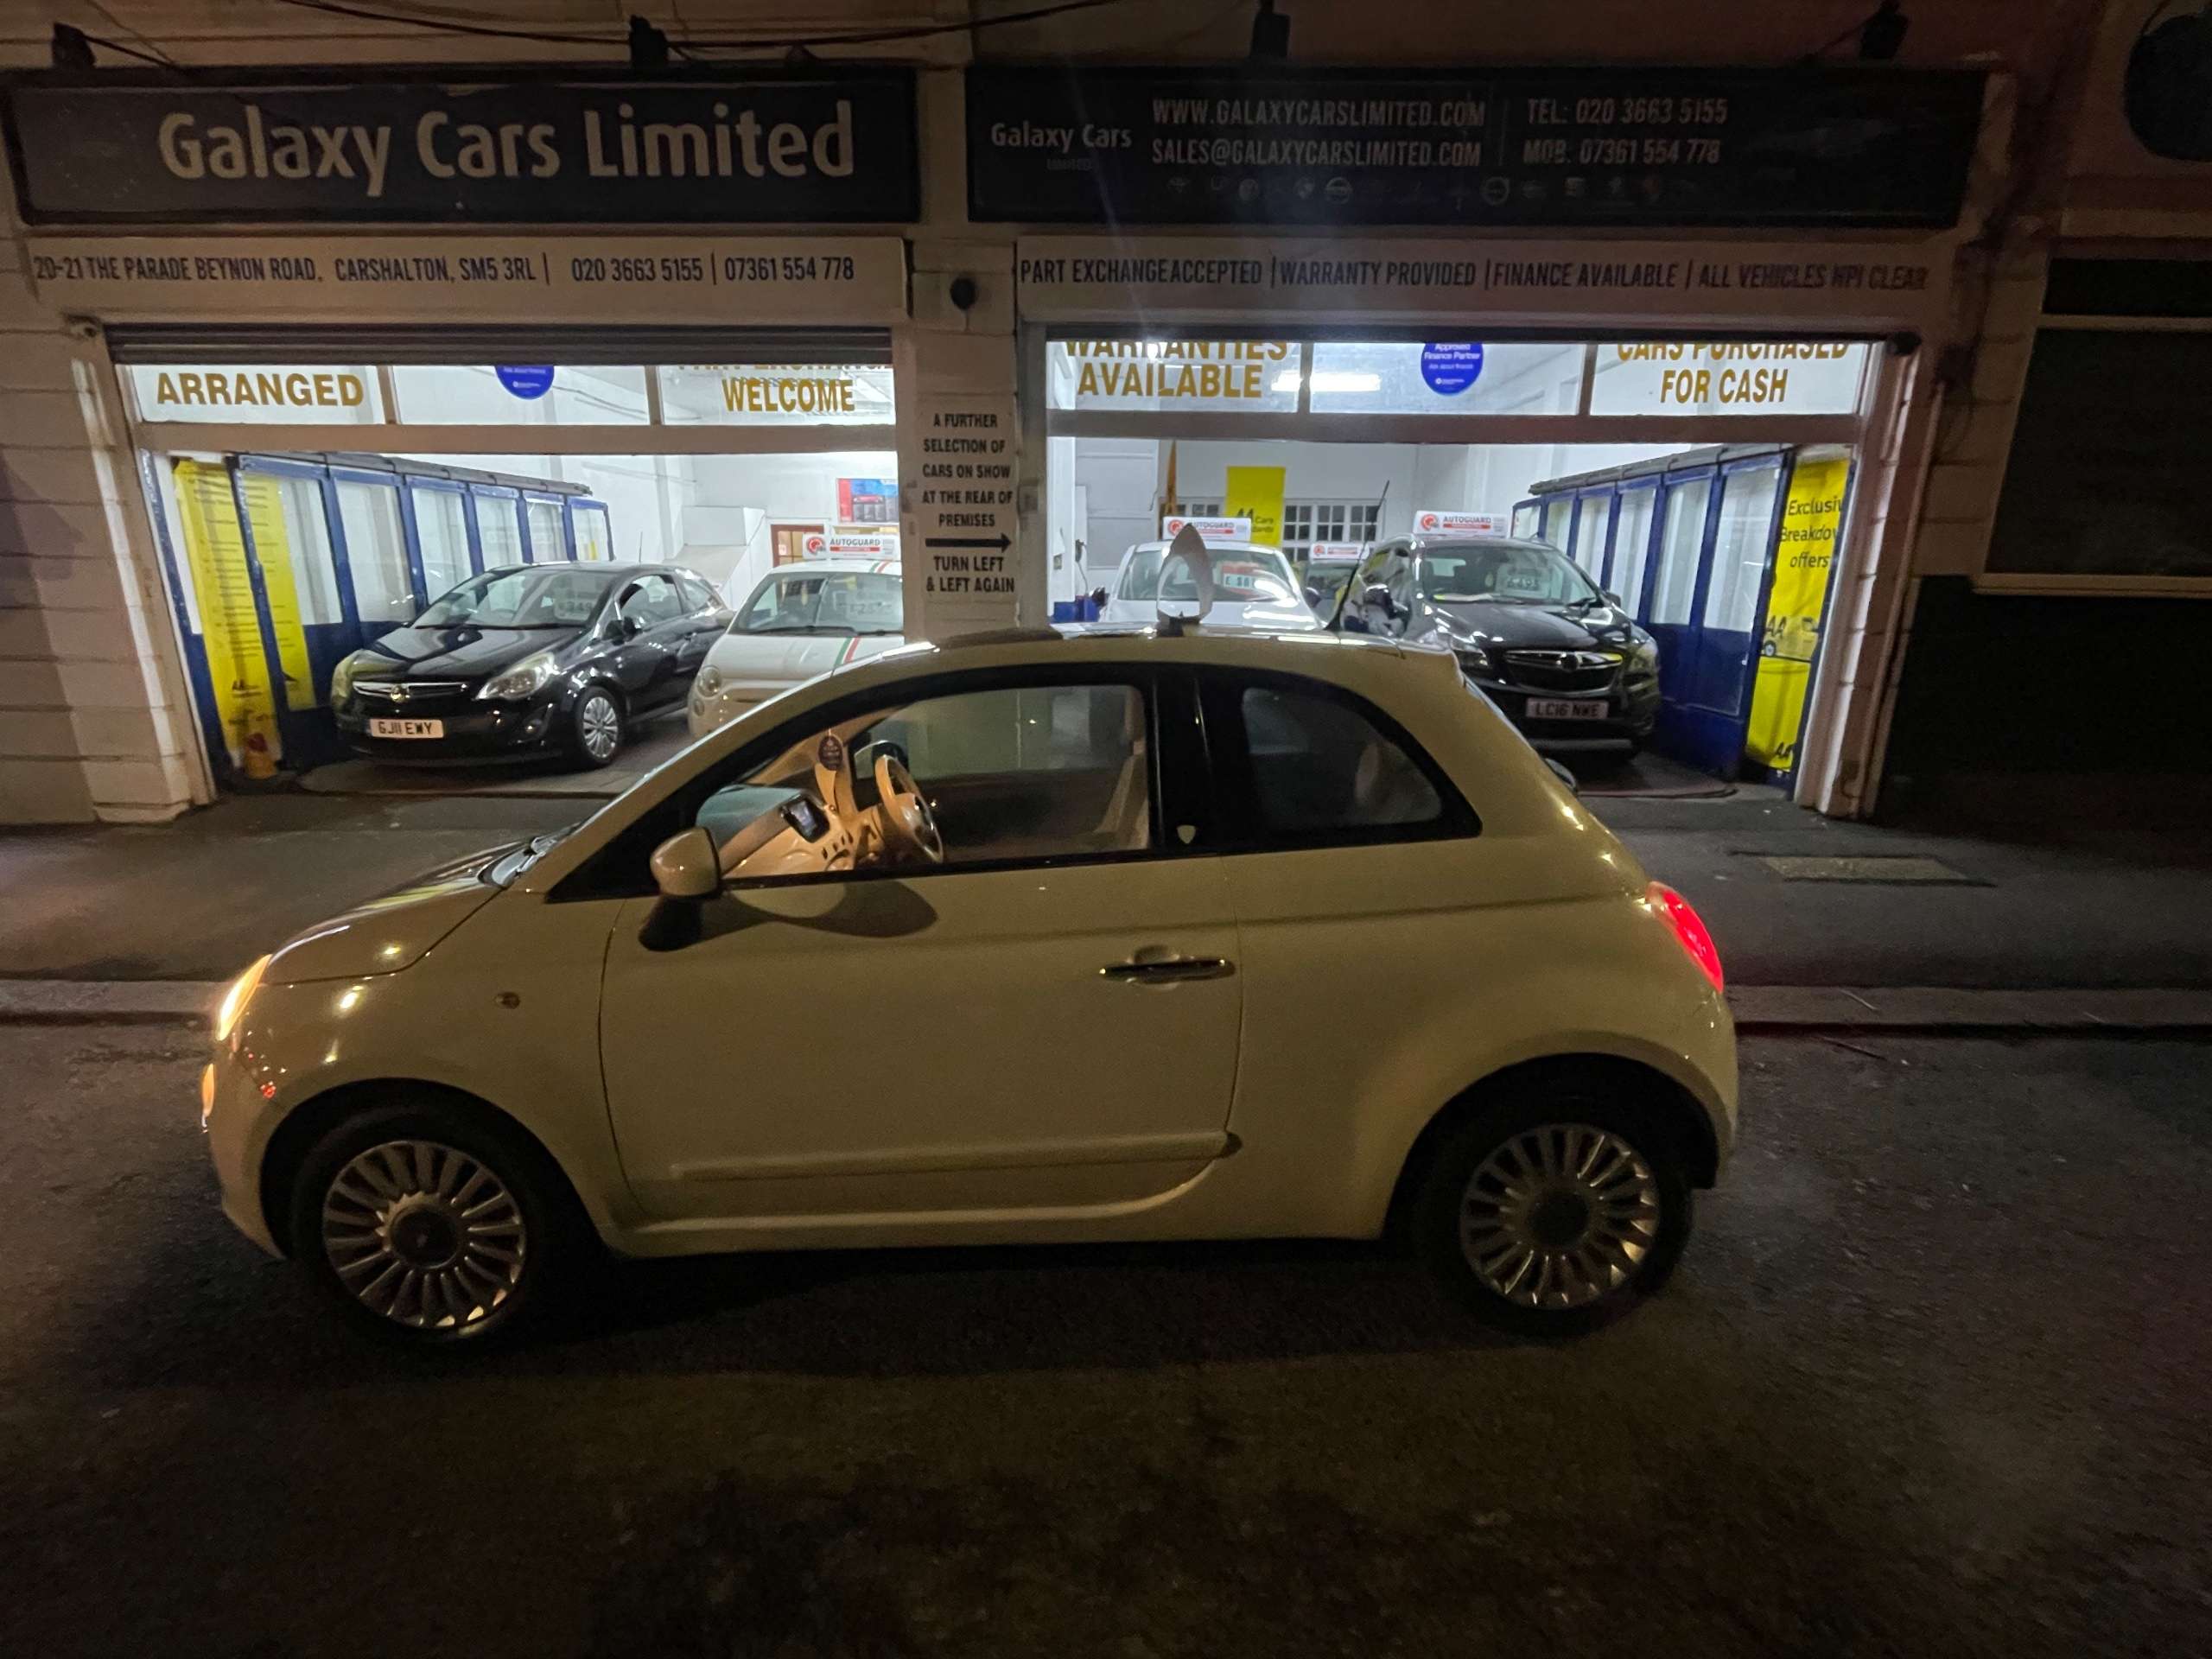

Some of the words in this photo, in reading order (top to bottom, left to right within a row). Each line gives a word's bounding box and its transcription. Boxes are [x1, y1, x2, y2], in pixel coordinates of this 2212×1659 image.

[1152, 98, 1485, 127] WWW.GALAXYCARSLIMITED.COM
[1527, 96, 1568, 124] TEL:
[1575, 97, 1616, 124] 020
[1619, 97, 1674, 124] 3663
[1678, 97, 1728, 124] 5155
[158, 105, 391, 197] Galaxy
[416, 111, 561, 179] Cars
[583, 99, 855, 178] Limited
[990, 120, 1075, 154] Galaxy
[1082, 124, 1133, 149] Cars
[1151, 138, 1481, 167] SALES@GALAXYCARSLIMITED.COM
[1579, 139, 1638, 165] 07361
[1643, 139, 1681, 165] 554
[1686, 139, 1721, 165] 778
[34, 257, 83, 280] 20-21
[86, 257, 119, 280] THE
[124, 257, 192, 281] PARADE
[194, 257, 265, 281] BEYNON
[459, 257, 499, 282] SM5
[504, 258, 536, 281] 3RL
[571, 257, 605, 281] 020
[610, 257, 656, 281] 3663
[661, 257, 703, 281] 5155
[724, 257, 778, 281] 07361
[783, 257, 817, 281] 554
[821, 257, 854, 281] 778
[1020, 259, 1066, 283] PART
[1071, 259, 1166, 284] EXCHANGE
[1169, 260, 1262, 285] ACCEPTED
[1281, 261, 1382, 286] WARRANTY
[1385, 261, 1476, 286] PROVIDED
[1493, 262, 1572, 287] FINANCE
[1576, 263, 1679, 288] AVAILABLE
[1699, 264, 1732, 288] ALL
[1738, 264, 1827, 289] VEHICLES
[156, 372, 364, 408] ARRANGED
[1077, 362, 1262, 398] AVAILABLE
[1660, 370, 1711, 404] FOR
[1719, 369, 1788, 404] CASH
[721, 377, 855, 412] WELCOME
[933, 413, 941, 427] A
[944, 414, 997, 428] FURTHER
[924, 438, 987, 453] SELECTION
[991, 439, 1005, 453] OF
[922, 463, 953, 478] CARS
[957, 464, 973, 478] ON
[976, 464, 1011, 478] SHOW
[922, 490, 935, 504] AT
[939, 491, 961, 504] THE
[965, 491, 995, 504] REAR
[998, 491, 1013, 505] OF
[938, 513, 995, 528] PREMISES
[933, 556, 969, 571] TURN
[973, 556, 1004, 572] LEFT
[1789, 552, 1830, 568] offers
[926, 576, 935, 592] &
[939, 577, 970, 592] LEFT
[975, 577, 1014, 593] AGAIN
[378, 721, 402, 734] GJ11
[404, 721, 432, 734] EWY
